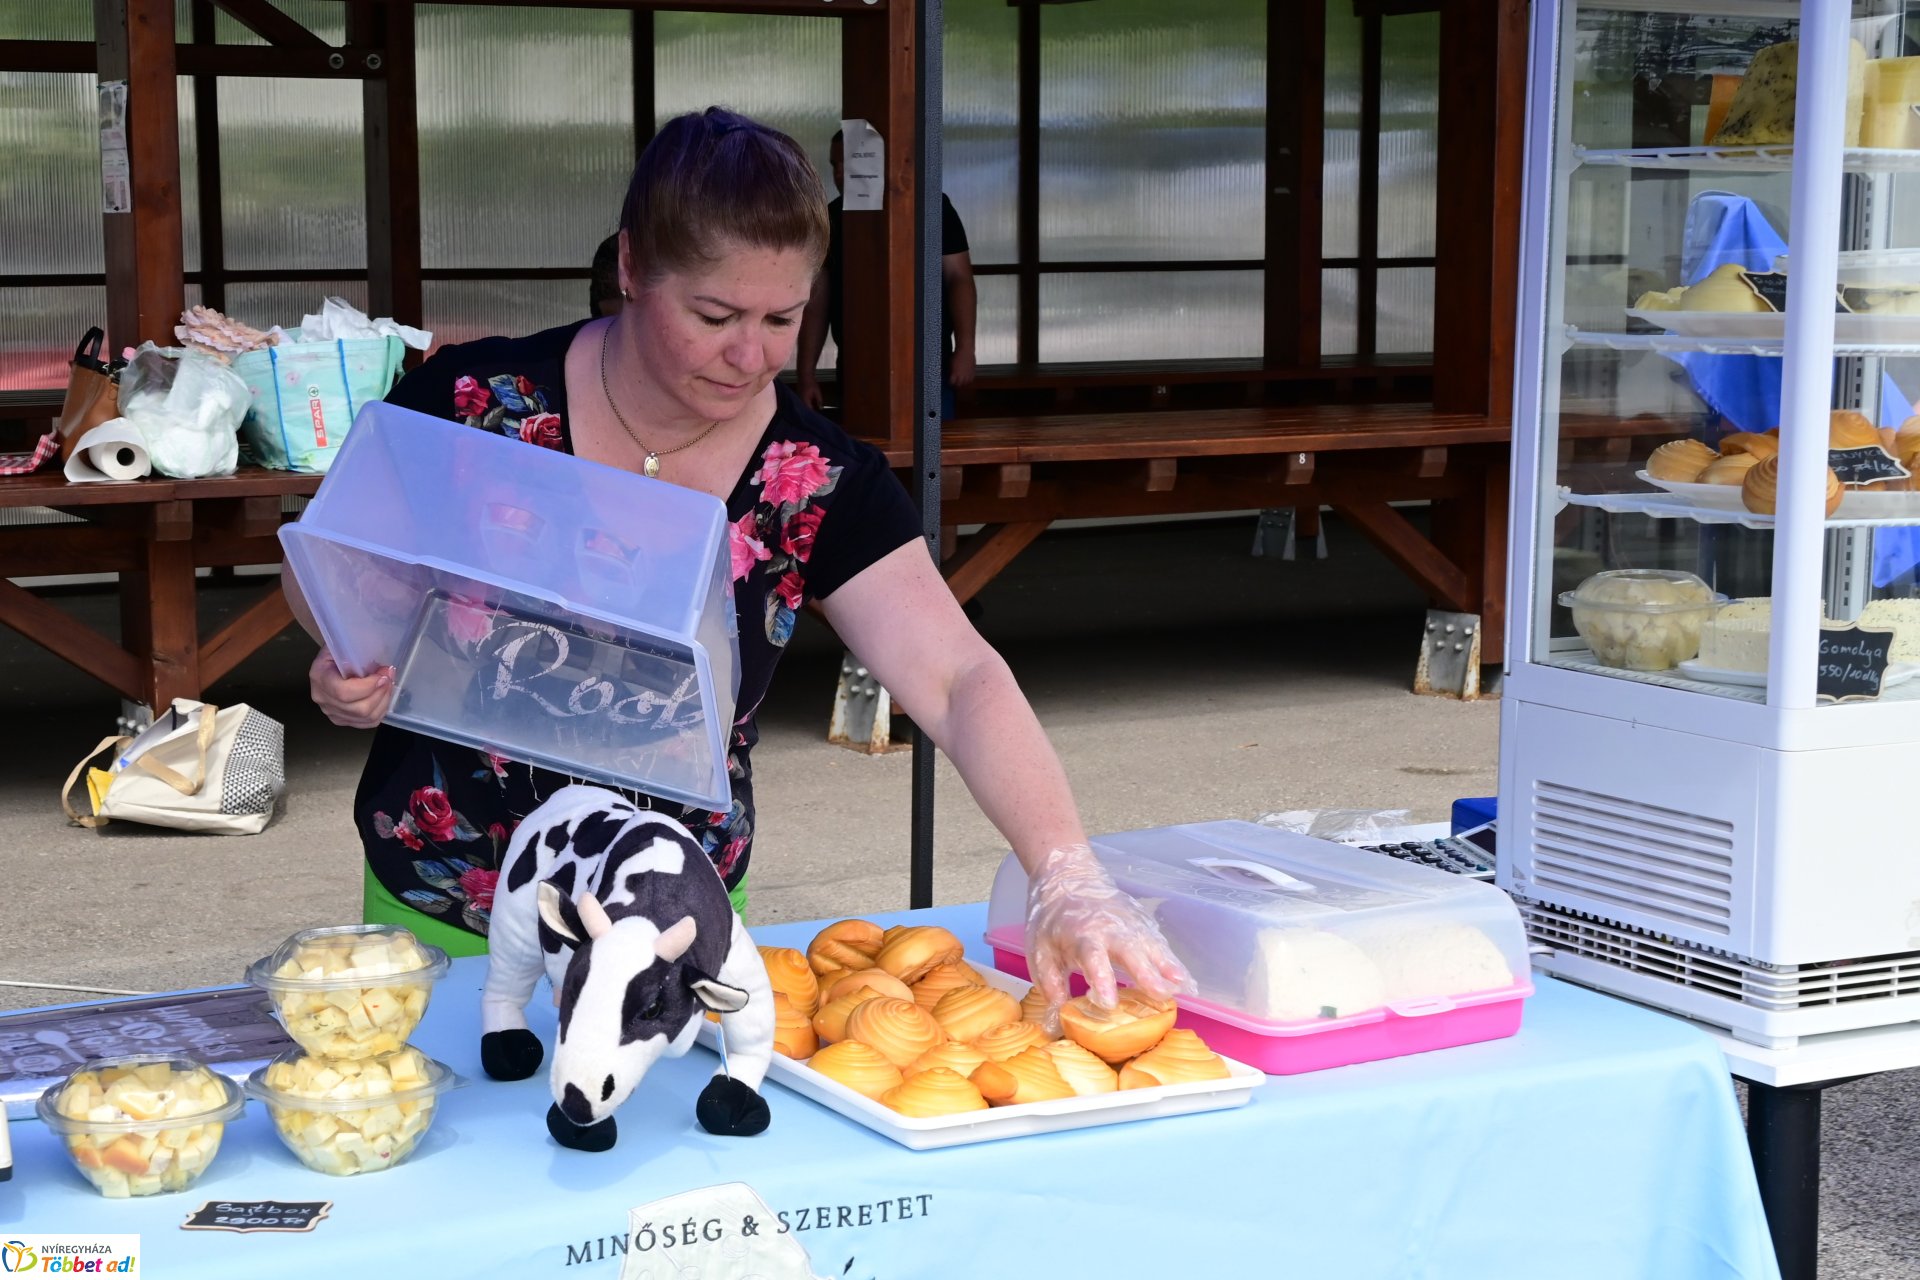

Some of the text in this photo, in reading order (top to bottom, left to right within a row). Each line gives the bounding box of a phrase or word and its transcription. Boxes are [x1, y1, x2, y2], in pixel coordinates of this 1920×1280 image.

[311, 400, 325, 439] SPAR
[1299, 452, 1306, 465] 8
[565, 1194, 933, 1266] MINŐSÉG & SZERETET
